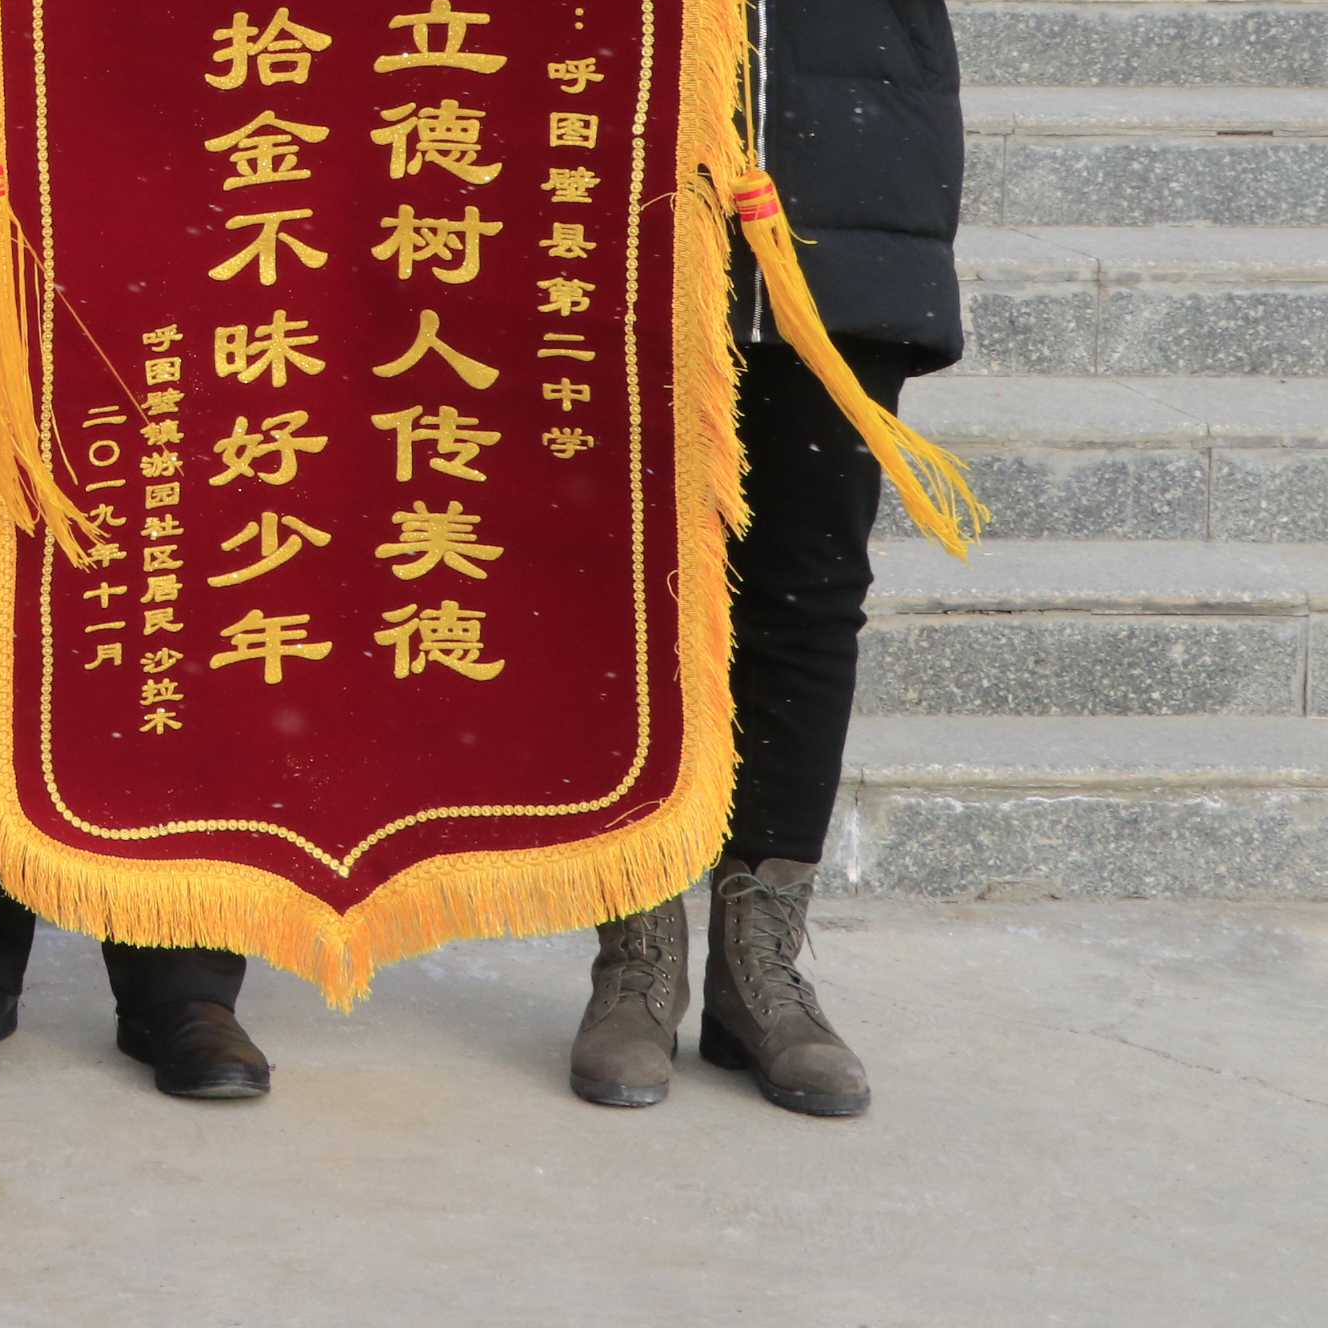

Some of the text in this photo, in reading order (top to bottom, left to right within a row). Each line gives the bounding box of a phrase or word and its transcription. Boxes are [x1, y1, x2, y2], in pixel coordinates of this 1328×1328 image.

[205, 8, 332, 684] 拾金不昧好少年
[140, 648, 184, 734] 沙拉木
